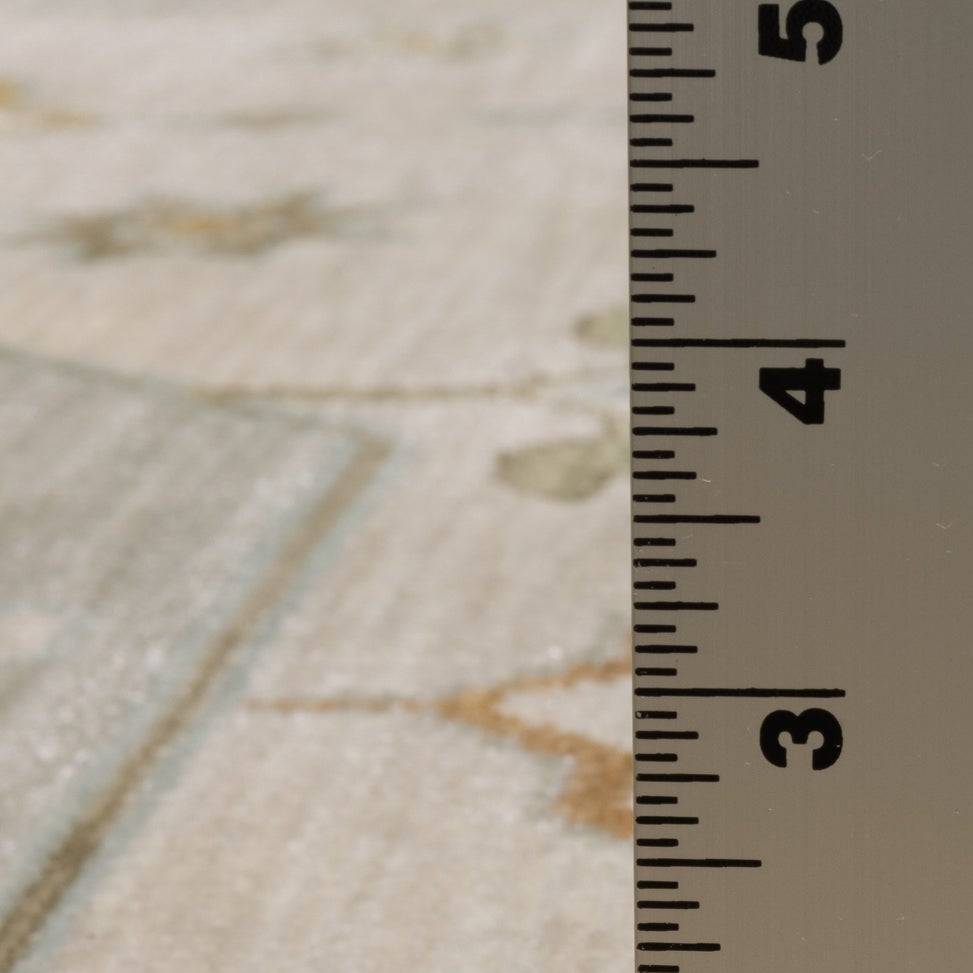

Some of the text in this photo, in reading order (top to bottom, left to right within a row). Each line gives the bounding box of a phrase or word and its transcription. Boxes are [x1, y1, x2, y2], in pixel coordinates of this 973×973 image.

[757, 0, 844, 66] 5
[758, 357, 842, 426] 4
[759, 707, 844, 771] 3
